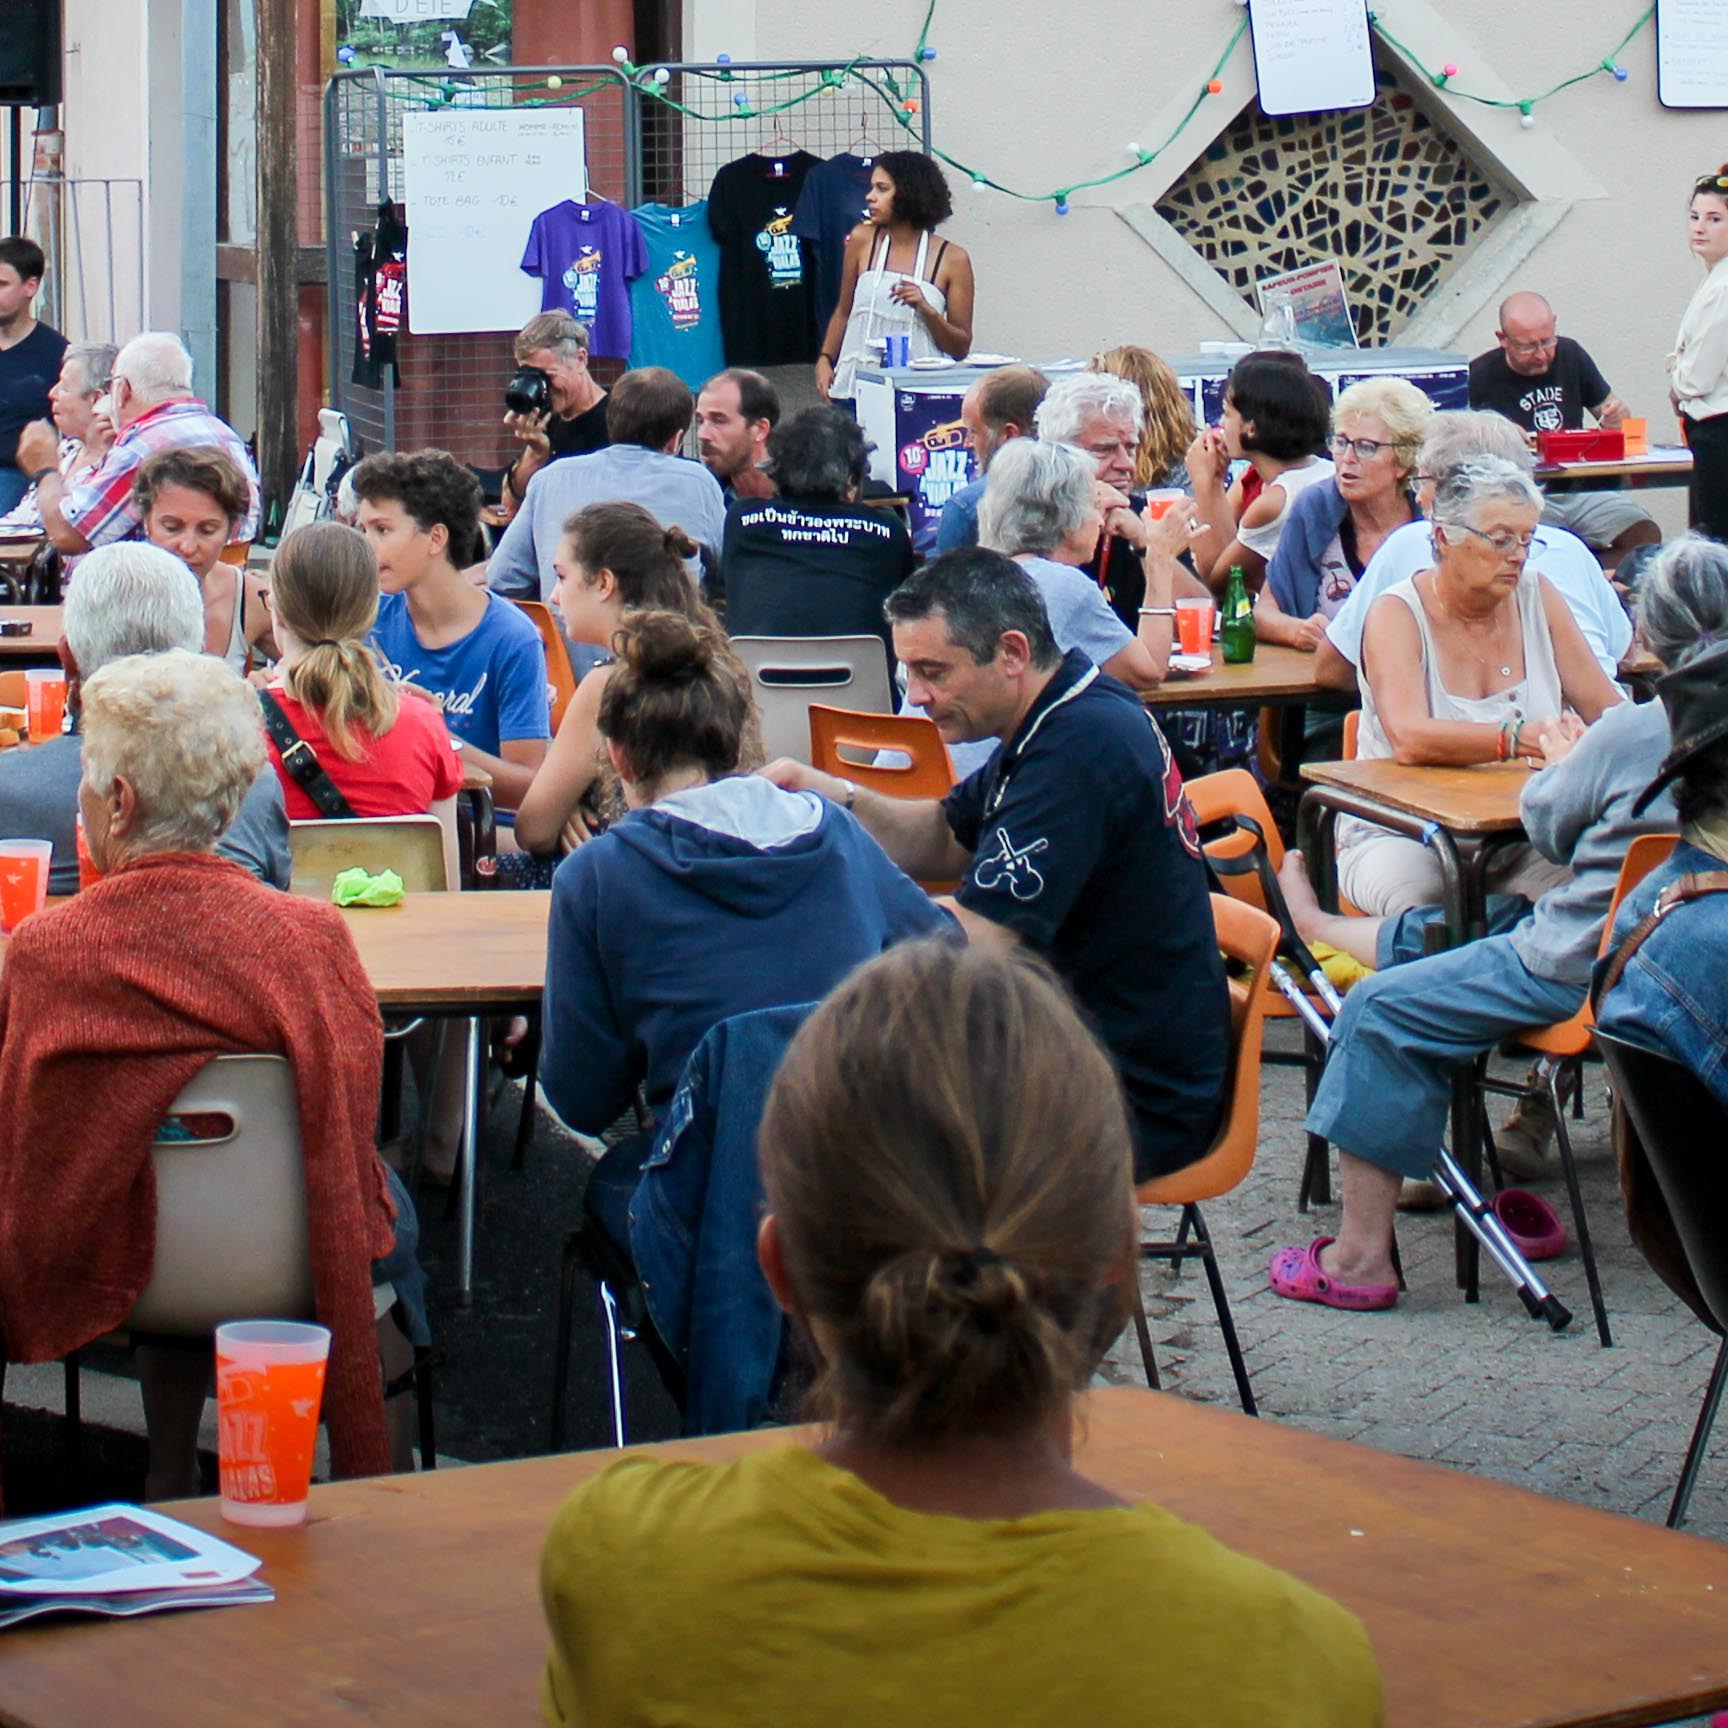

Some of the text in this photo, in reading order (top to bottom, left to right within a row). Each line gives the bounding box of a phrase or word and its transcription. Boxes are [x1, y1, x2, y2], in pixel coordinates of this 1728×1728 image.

[476, 153, 518, 167] ENFANT
[455, 195, 481, 207] BAG
[772, 234, 798, 254] JAZZ
[672, 277, 697, 298] JAZZ
[1520, 386, 1563, 412] STADE
[925, 449, 968, 481] JAZZ
[219, 1410, 269, 1462] AZZ
